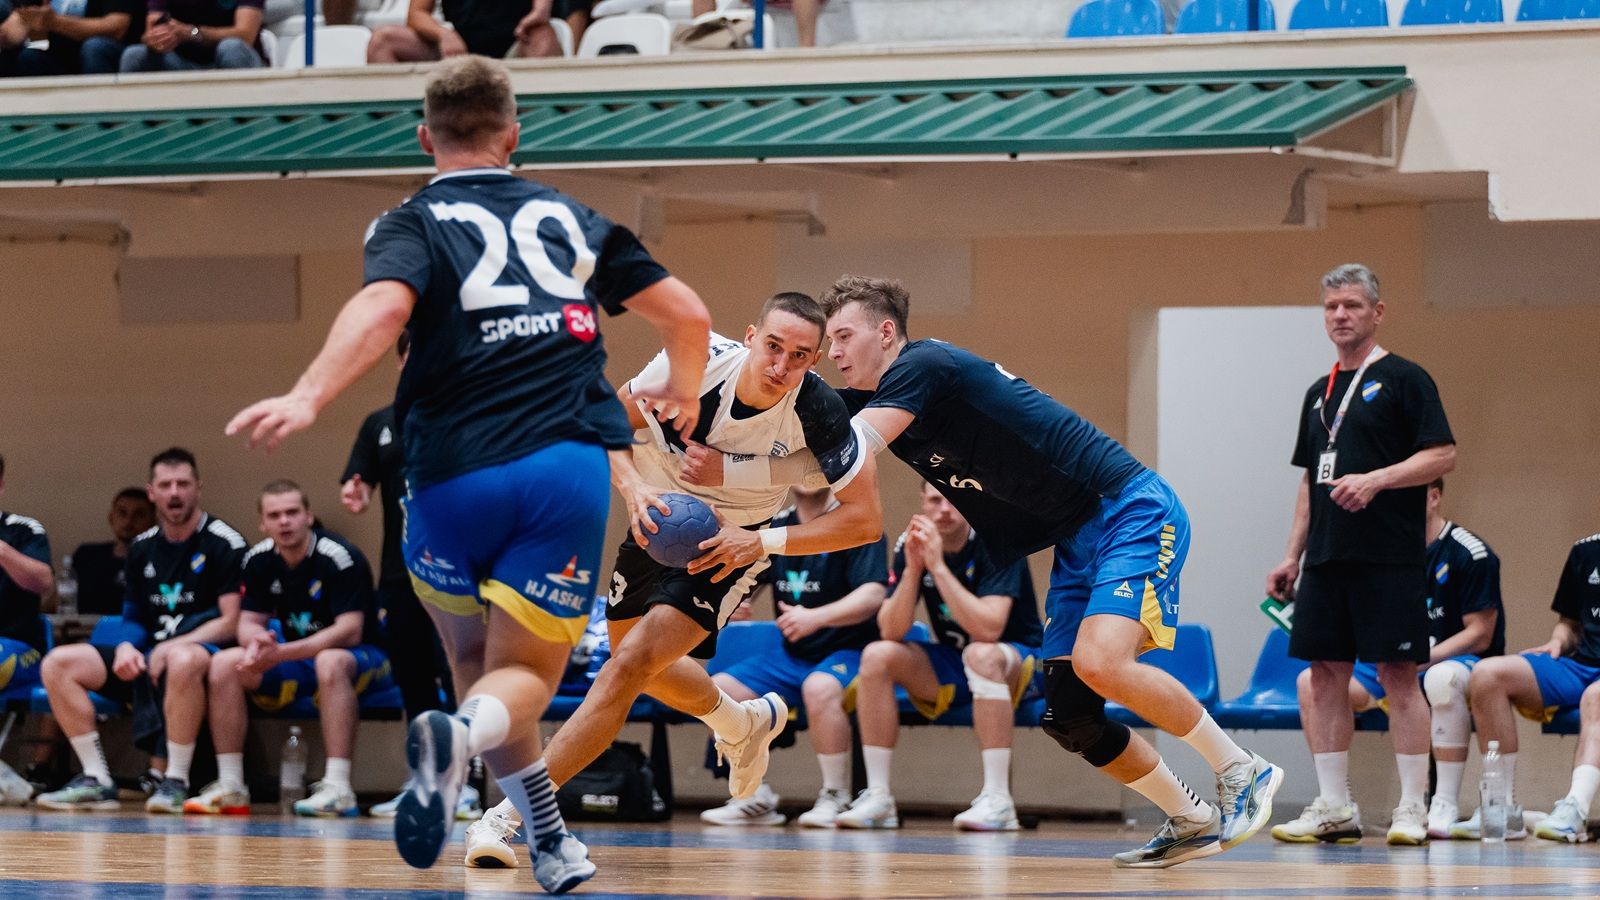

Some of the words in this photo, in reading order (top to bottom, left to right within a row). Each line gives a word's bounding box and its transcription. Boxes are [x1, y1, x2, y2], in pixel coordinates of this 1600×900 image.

[428, 199, 597, 311] 20
[480, 312, 562, 343] SPORT
[569, 309, 597, 335] 24
[1321, 464, 1331, 479] B
[524, 579, 547, 599] HJ
[608, 571, 628, 607] 3
[1113, 590, 1134, 599] SELECT
